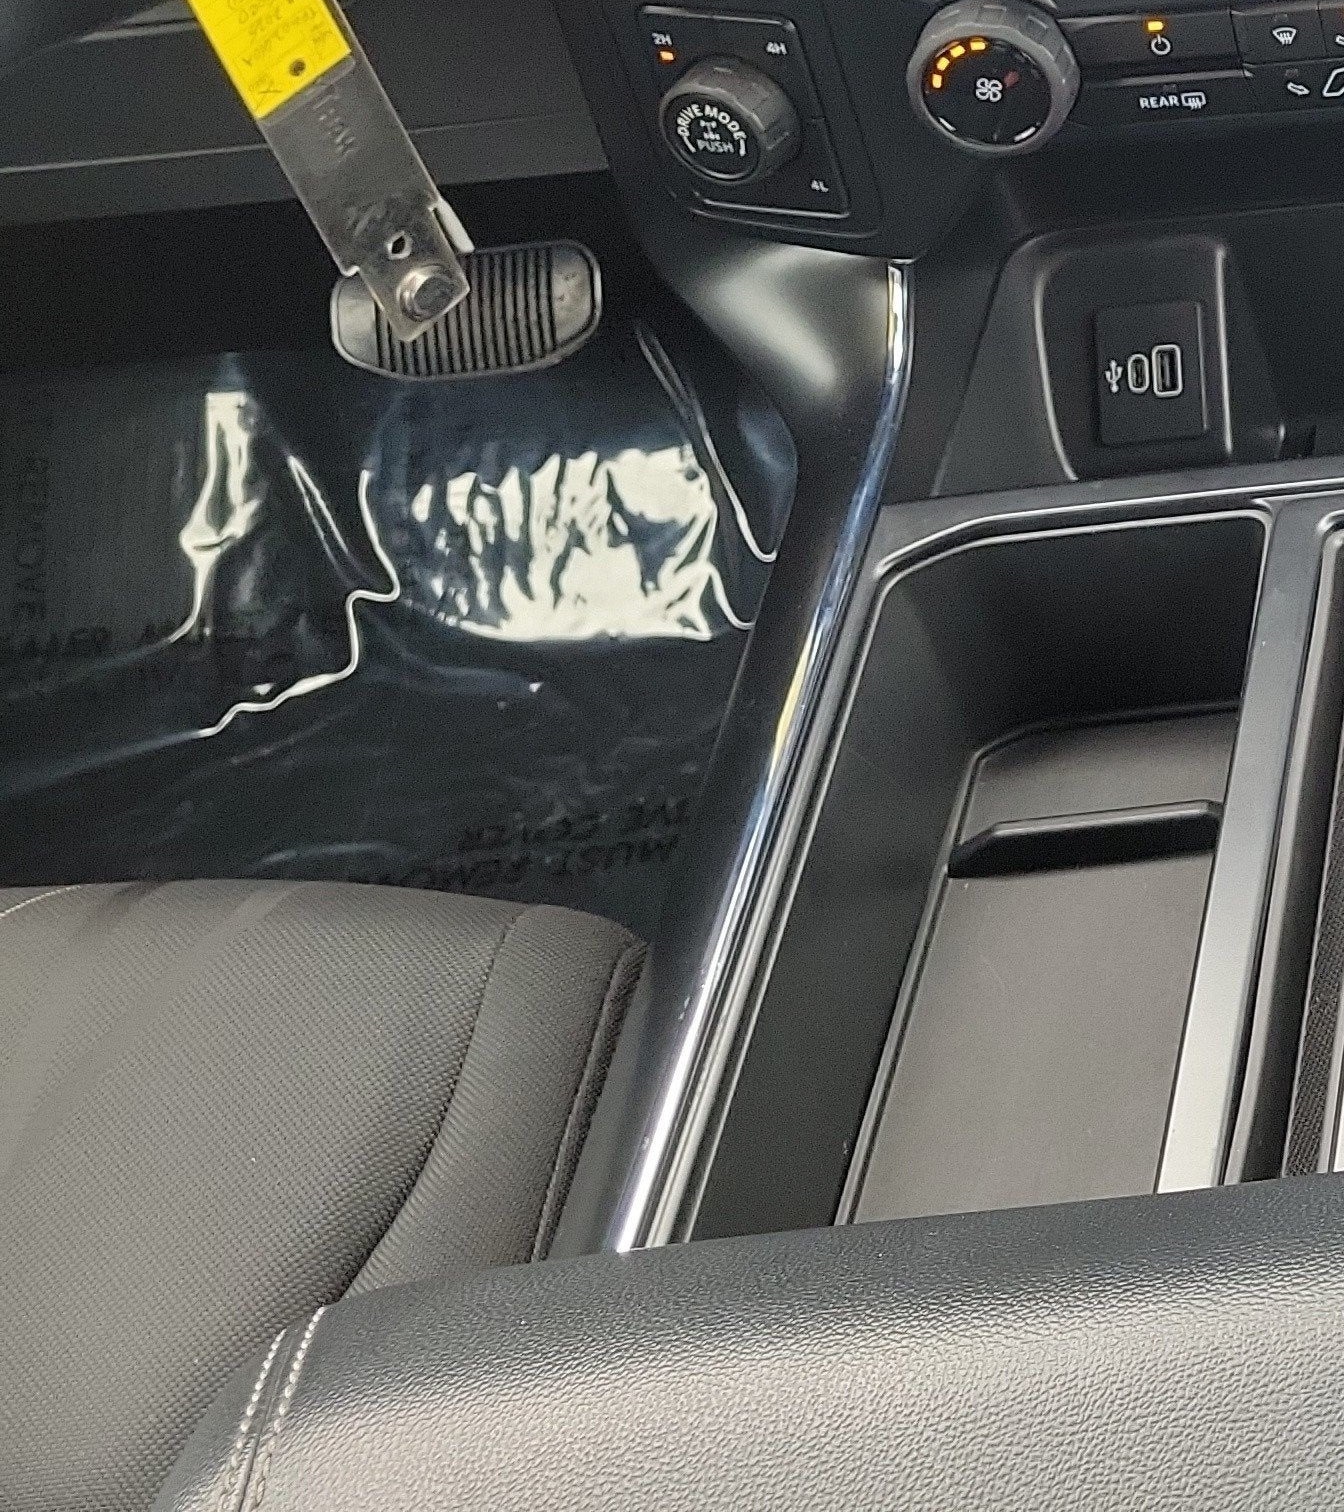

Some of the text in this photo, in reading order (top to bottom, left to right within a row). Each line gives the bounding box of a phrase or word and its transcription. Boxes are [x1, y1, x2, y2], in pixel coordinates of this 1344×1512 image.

[651, 31, 673, 47] 2H
[765, 41, 789, 56] 4H
[1138, 94, 1180, 111] REAR
[676, 103, 747, 141] DRIVE MODE
[696, 138, 735, 154] PUSH
[810, 179, 830, 193] 4L
